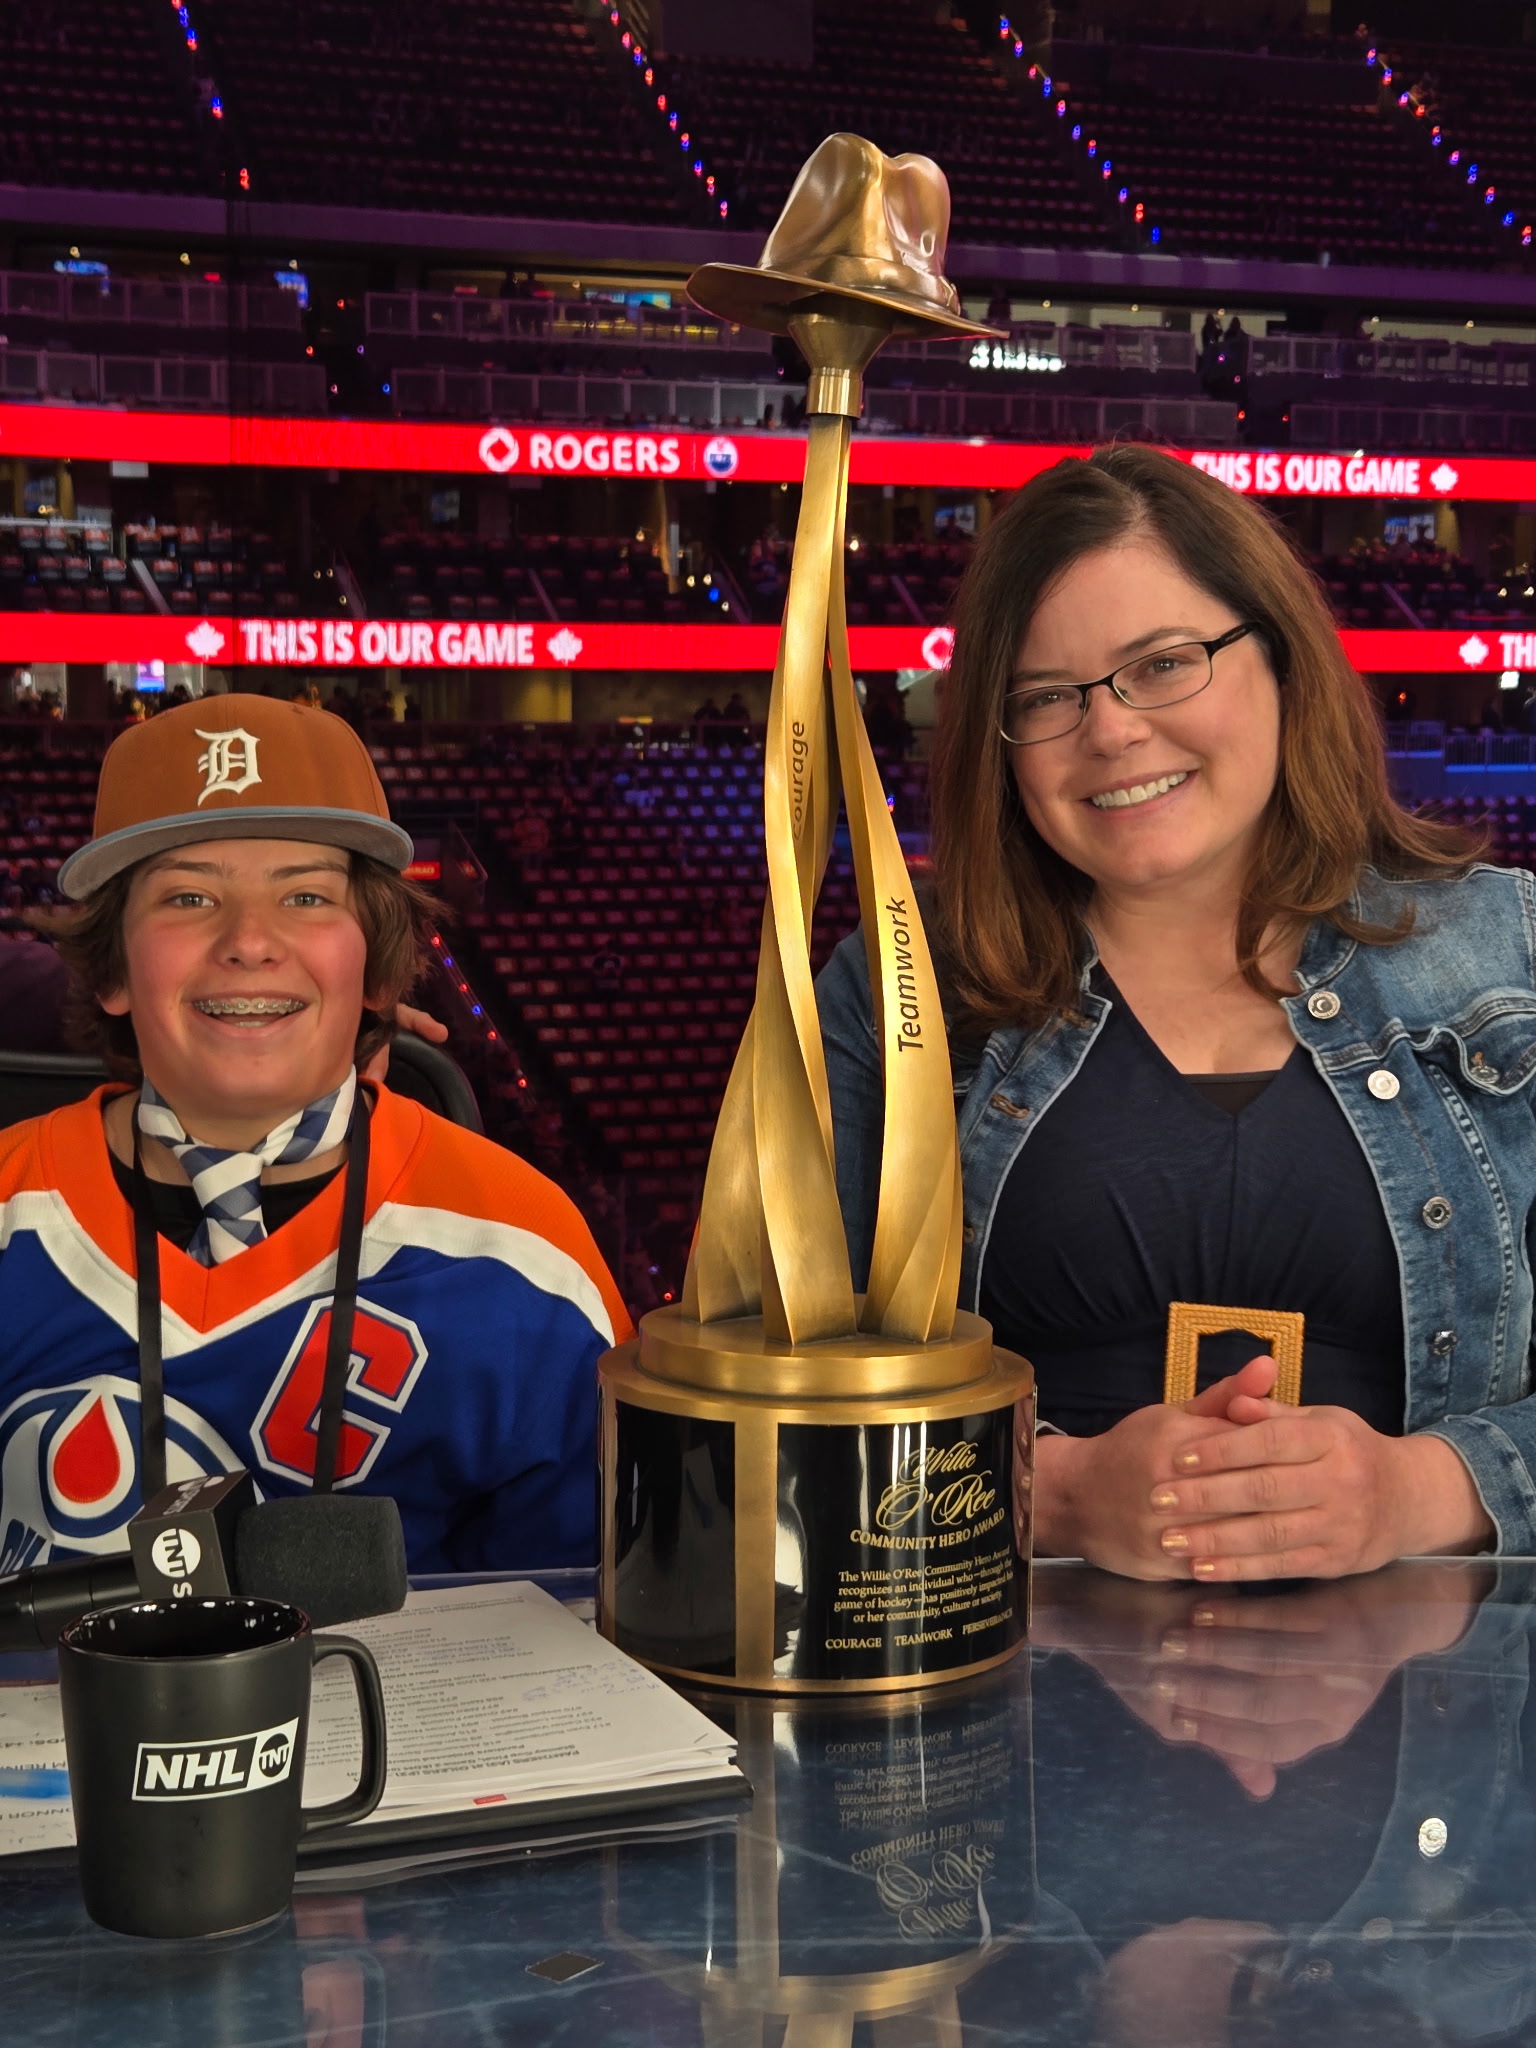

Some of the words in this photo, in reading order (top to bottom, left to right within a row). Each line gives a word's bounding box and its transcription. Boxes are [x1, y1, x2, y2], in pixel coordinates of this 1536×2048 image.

[529, 433, 681, 474] ROGERS
[1255, 454, 1281, 491] IS
[1284, 456, 1343, 493] OUR
[1345, 457, 1421, 494] GAME
[240, 619, 316, 664] THIS
[321, 621, 354, 664] IS
[359, 622, 434, 665] OUR
[437, 624, 535, 666] GAME
[194, 727, 262, 807] D
[886, 896, 924, 1053] Teamwork
[249, 1295, 429, 1491] C
[899, 1441, 979, 1482] Willie
[850, 1529, 936, 1550] COMMUNITY
[938, 1528, 971, 1548] HERO
[972, 1507, 1005, 1538] AWARD
[163, 1528, 188, 1574] TNT
[839, 1570, 859, 1582] The
[861, 1569, 891, 1581] Willie
[893, 1567, 923, 1579] O'Ree
[924, 1560, 974, 1576] Community
[834, 1601, 863, 1612] game
[864, 1598, 876, 1609] of
[878, 1596, 913, 1609] hockey
[940, 1584, 978, 1604] positively
[838, 1585, 892, 1598] recognizes
[894, 1584, 907, 1593] an
[909, 1575, 955, 1592] individual
[853, 1614, 865, 1623] or
[867, 1611, 885, 1623] her
[886, 1605, 941, 1621] community,
[942, 1601, 971, 1614] culture
[825, 1637, 882, 1649] COURAGE
[894, 1627, 953, 1647] TEAMWORK
[144, 1749, 244, 1790] NHL
[260, 1743, 289, 1770] TNT
